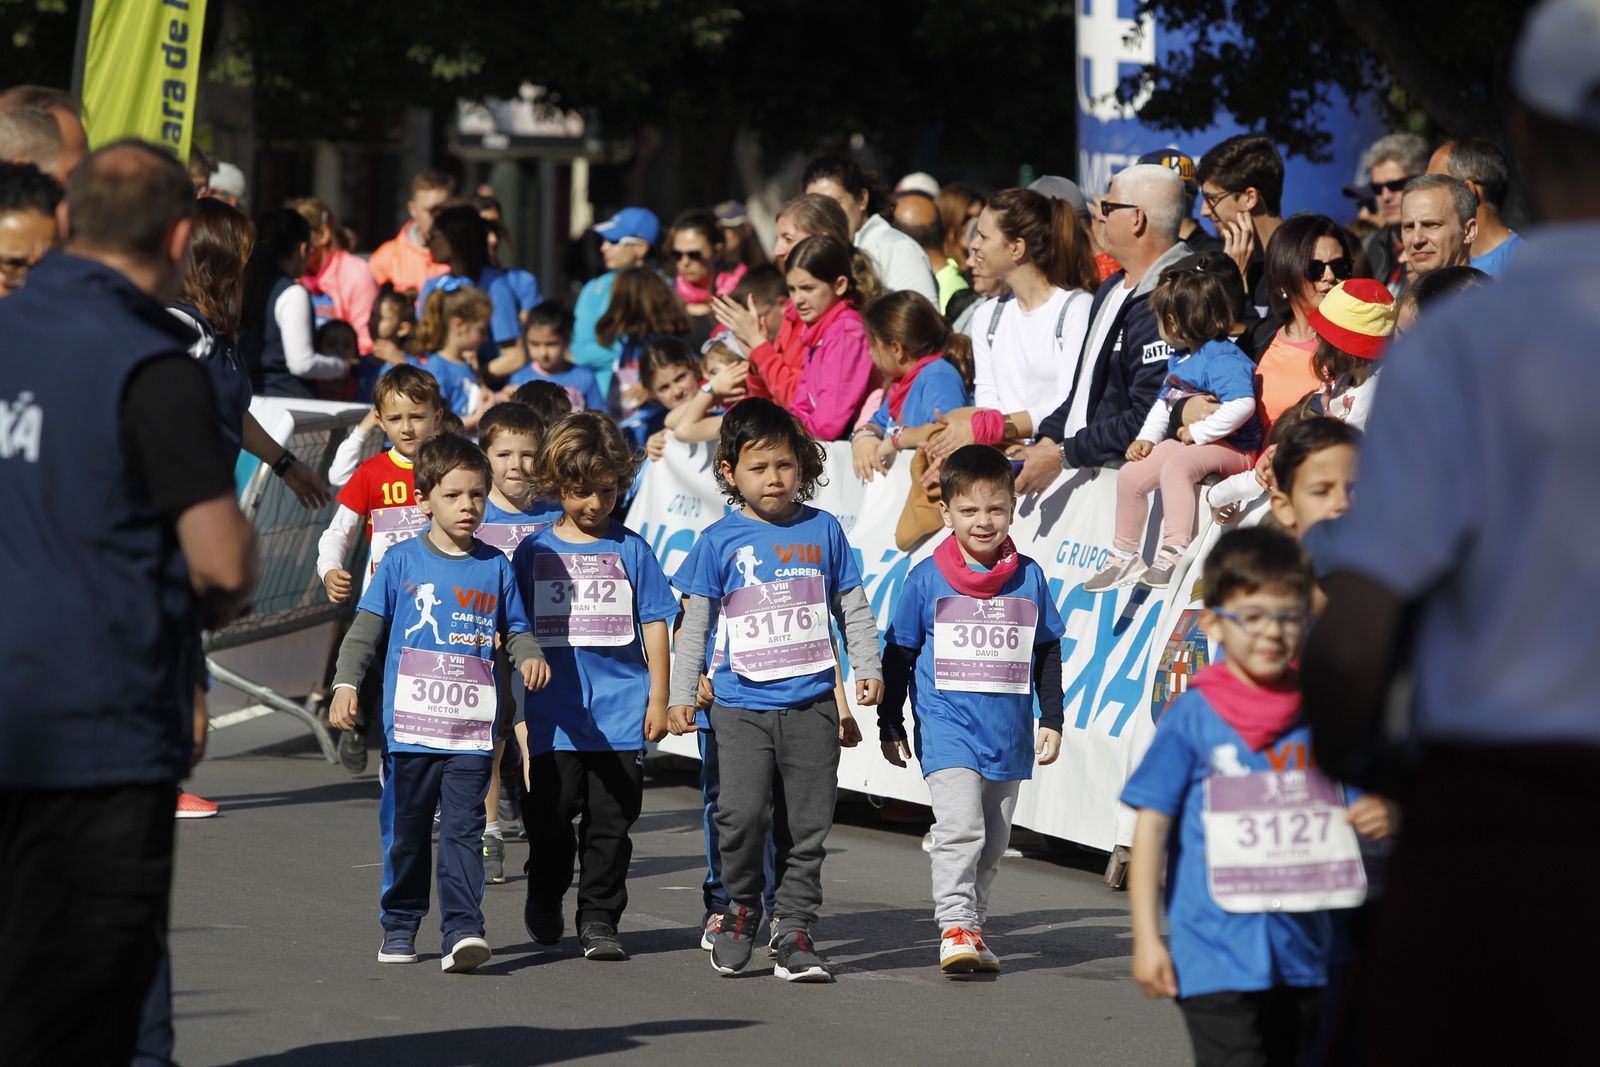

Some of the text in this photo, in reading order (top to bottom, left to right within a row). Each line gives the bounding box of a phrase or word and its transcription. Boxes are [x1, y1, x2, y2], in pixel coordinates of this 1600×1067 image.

[161, 19, 189, 157] ara de
[382, 481, 407, 505] 10
[774, 543, 821, 565] VIII
[1056, 540, 1109, 571] GRUPO
[550, 580, 616, 604] 3142
[772, 582, 789, 590] VIII
[454, 586, 496, 615] VIII
[744, 606, 812, 639] 3176
[768, 634, 792, 644] ARITZ
[952, 624, 1019, 650] 3066
[449, 655, 465, 664] VIII
[411, 678, 479, 708] 3006
[427, 704, 460, 715] HECTOR
[1236, 810, 1333, 848] 3127
